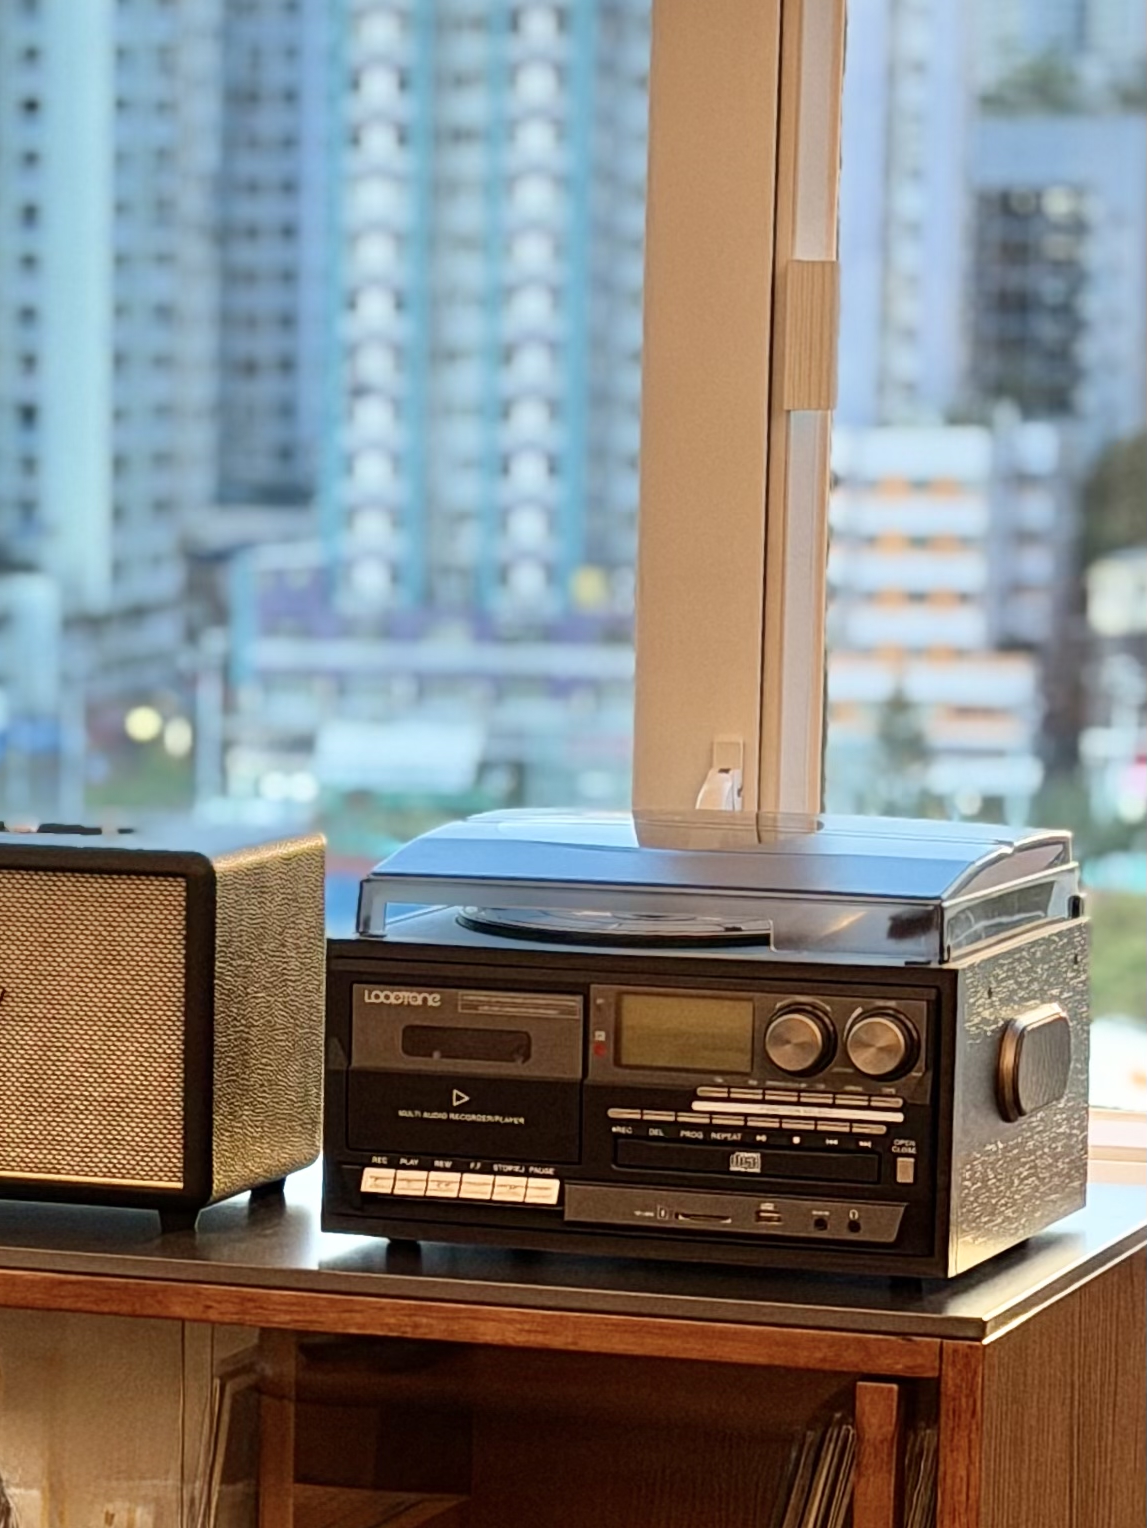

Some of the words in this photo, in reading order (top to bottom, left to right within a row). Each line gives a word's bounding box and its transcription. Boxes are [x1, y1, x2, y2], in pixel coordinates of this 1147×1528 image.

[648, 1127, 665, 1137] DEL
[679, 1129, 704, 1139] PROG
[710, 1131, 743, 1141] REPEAT
[893, 1138, 916, 1147] OPEN
[371, 1156, 388, 1165] REC
[399, 1157, 420, 1166] PLAY
[433, 1159, 453, 1169] REW
[528, 1165, 556, 1176] PAUSE
